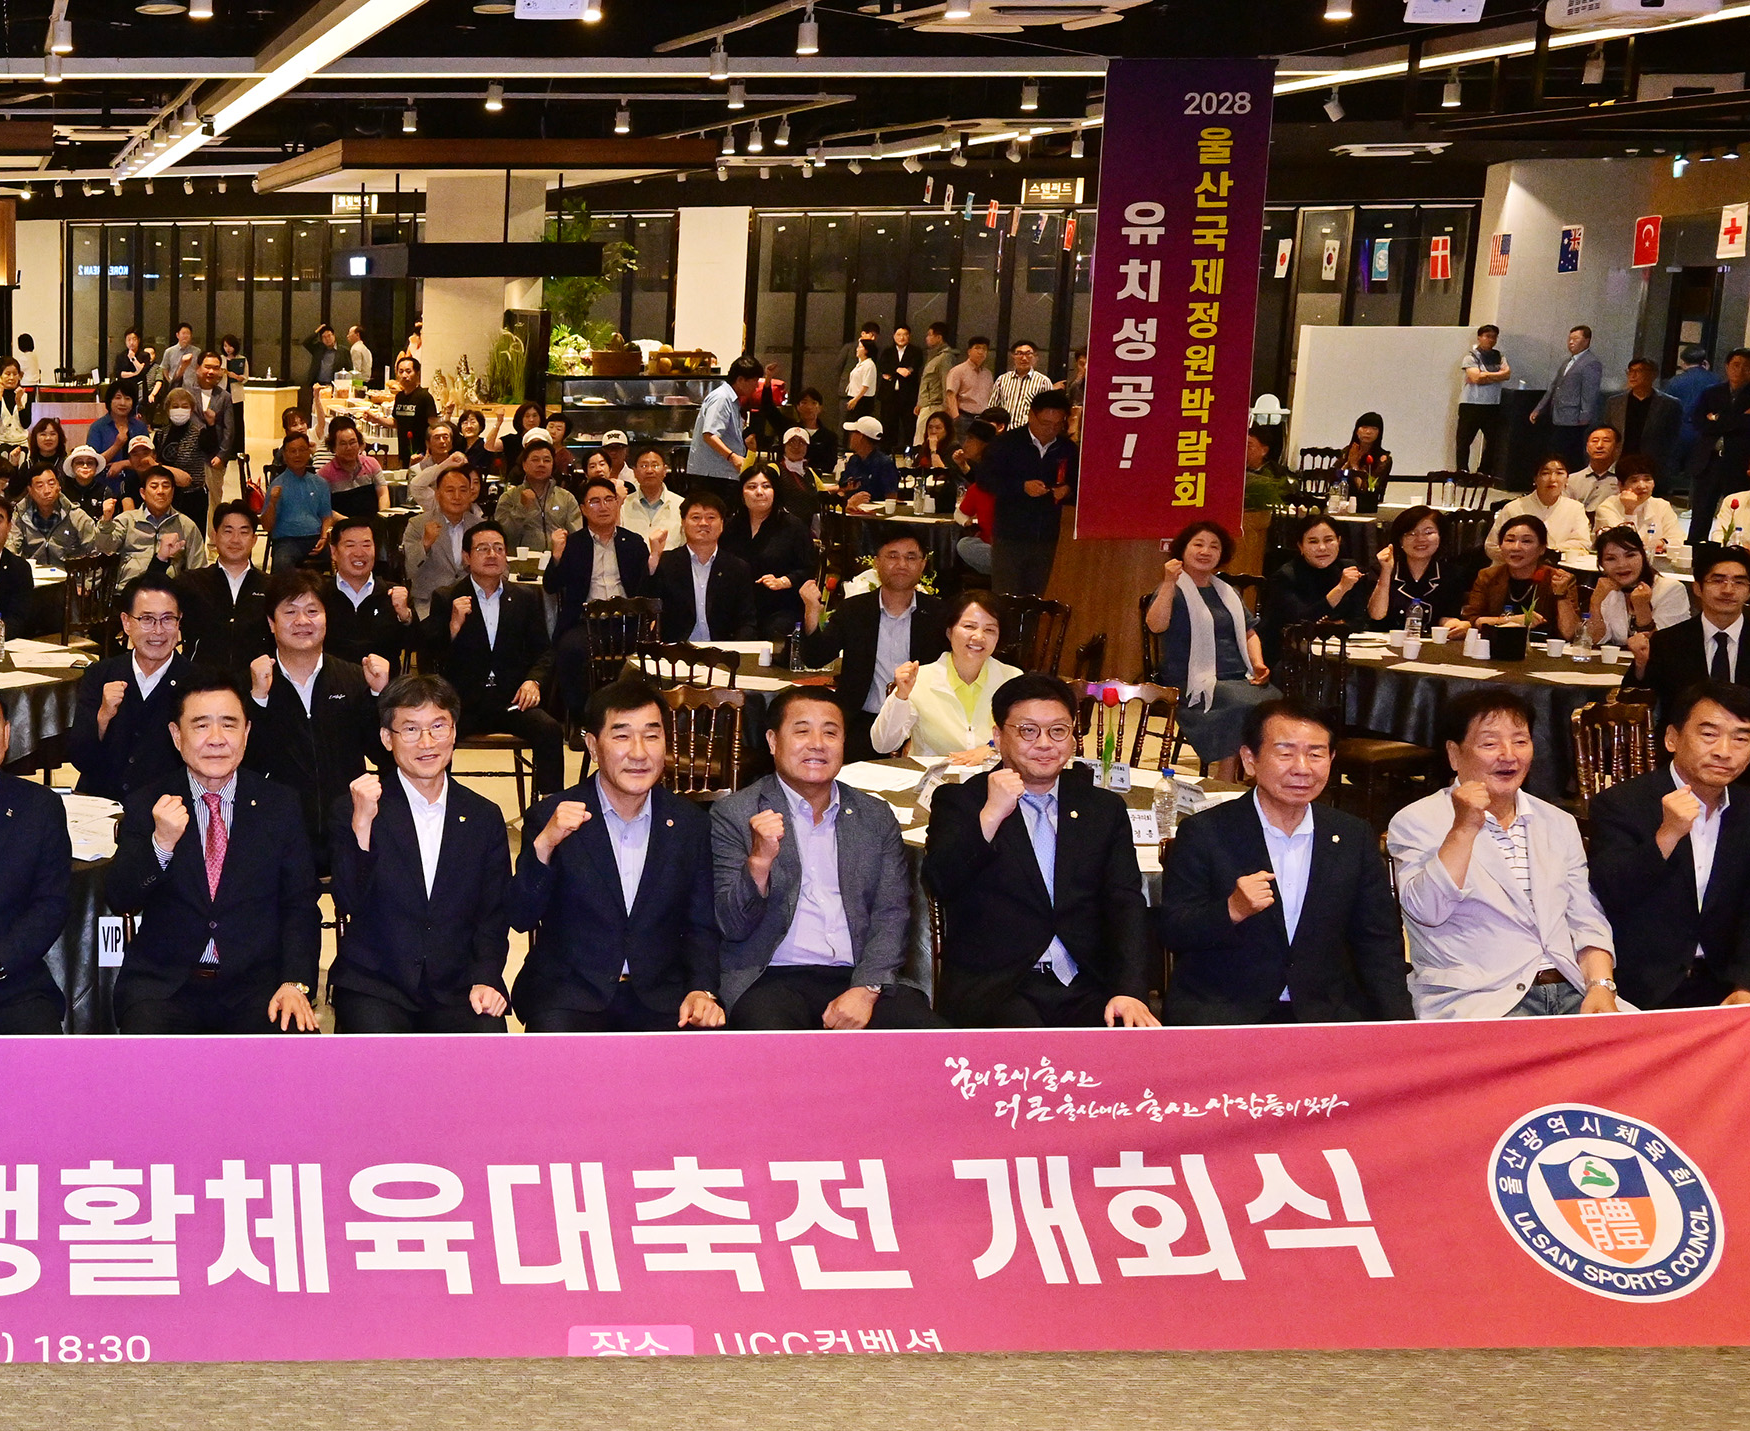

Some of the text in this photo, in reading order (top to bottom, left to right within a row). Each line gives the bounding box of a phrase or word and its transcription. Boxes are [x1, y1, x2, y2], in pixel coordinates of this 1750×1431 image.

[1183, 91, 1252, 116] 2028
[1107, 201, 1167, 470] 유치성공!
[1171, 127, 1234, 508] 울산국제정원박람회
[102, 926, 121, 953] VIP
[1032, 1056, 1102, 1093] 울산
[994, 1093, 1020, 1130] 더
[1025, 1095, 1055, 1122] 큰
[1055, 1093, 1134, 1122] 울산에는
[1135, 1087, 1207, 1123] 울산
[1205, 1092, 1301, 1120] 사람들이
[1498, 1114, 1698, 1196] 울산광역시체육회
[951, 1148, 1395, 1285] 개회식
[1514, 1204, 1710, 1291] ULSAN SPORTS COUNCIL
[34, 1335, 151, 1363] 18:30
